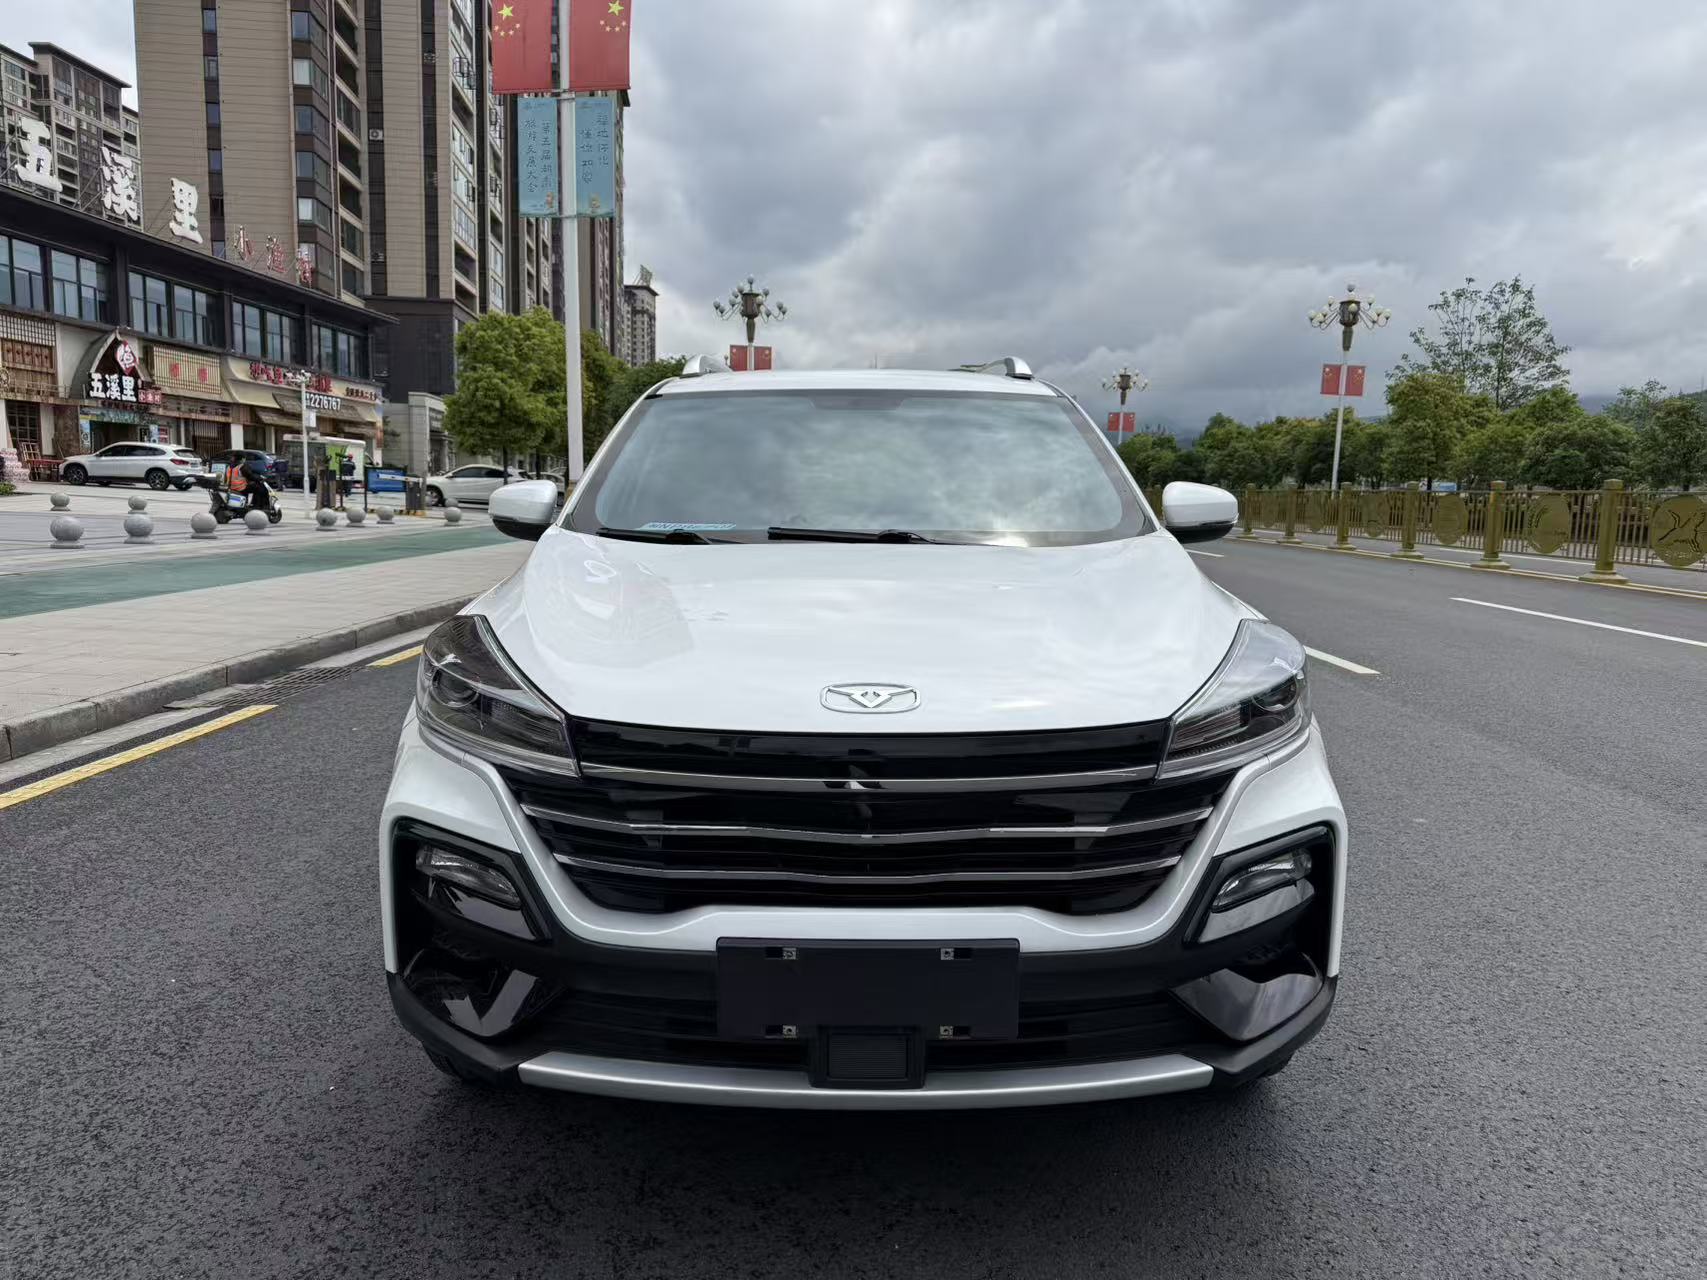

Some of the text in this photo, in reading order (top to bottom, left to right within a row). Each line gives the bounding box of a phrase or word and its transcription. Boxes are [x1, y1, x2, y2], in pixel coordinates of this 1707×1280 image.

[14, 116, 204, 244] 五溪里
[89, 372, 137, 402] 五溪里
[310, 394, 341, 411] 2276767
